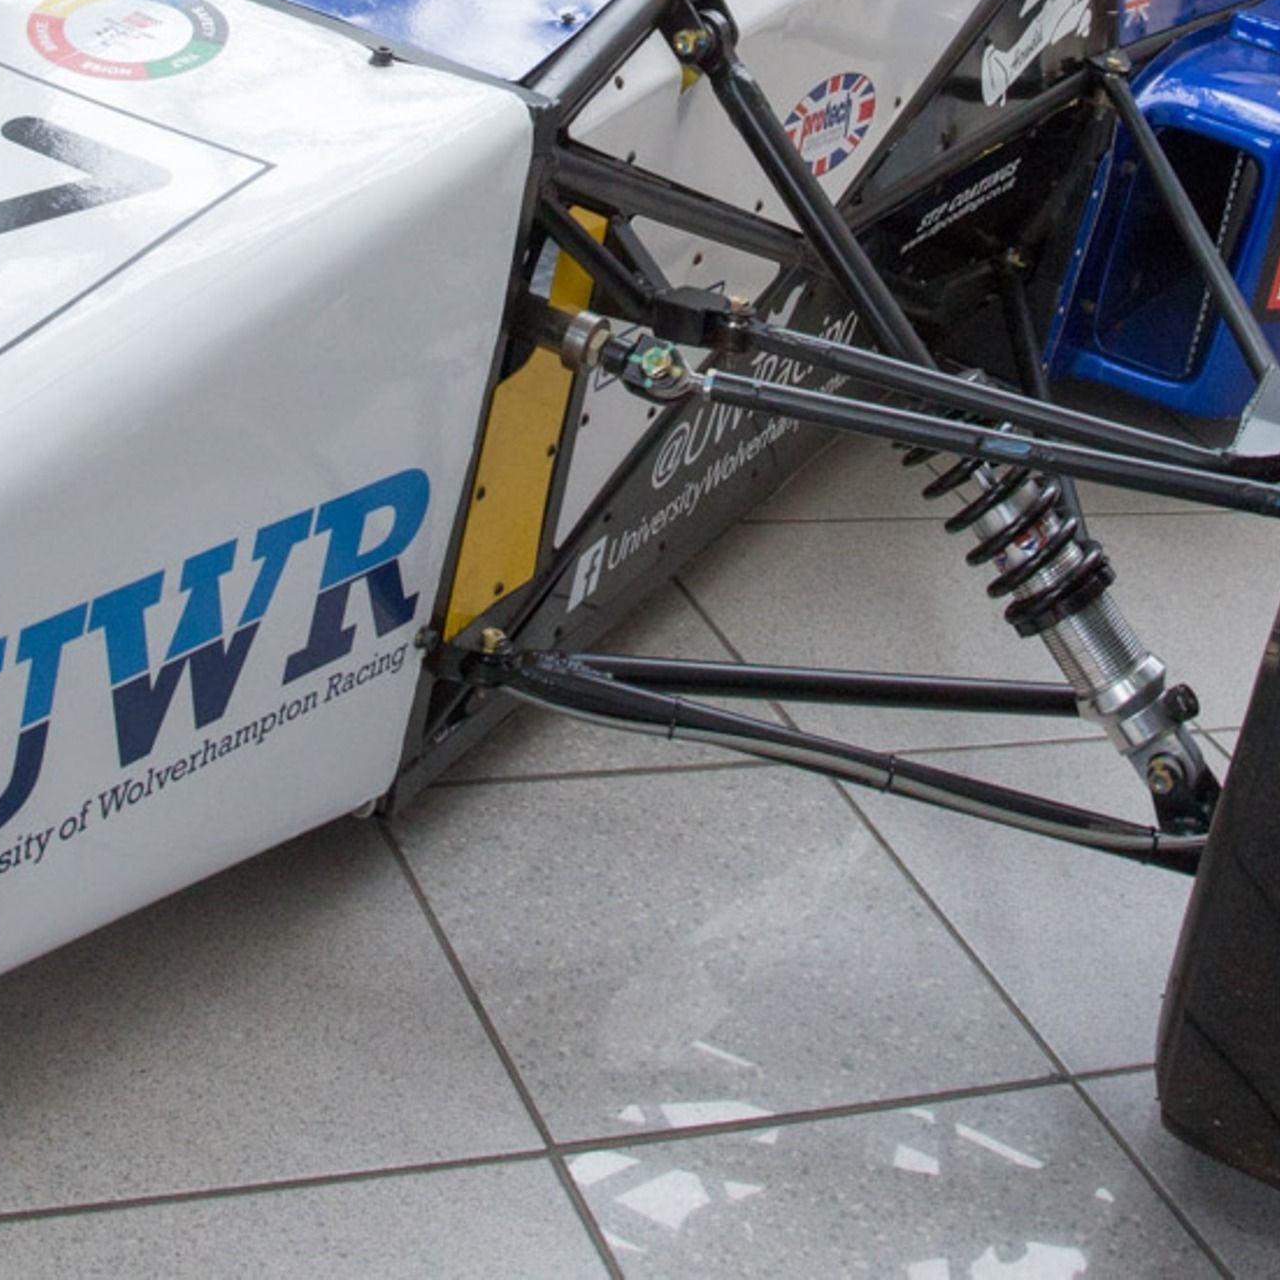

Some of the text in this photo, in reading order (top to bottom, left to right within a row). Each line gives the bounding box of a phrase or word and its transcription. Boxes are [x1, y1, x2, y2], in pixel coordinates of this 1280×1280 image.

[58, 800, 93, 843] of
[98, 691, 319, 821] Wolverhampton
[322, 642, 409, 708] Racing
